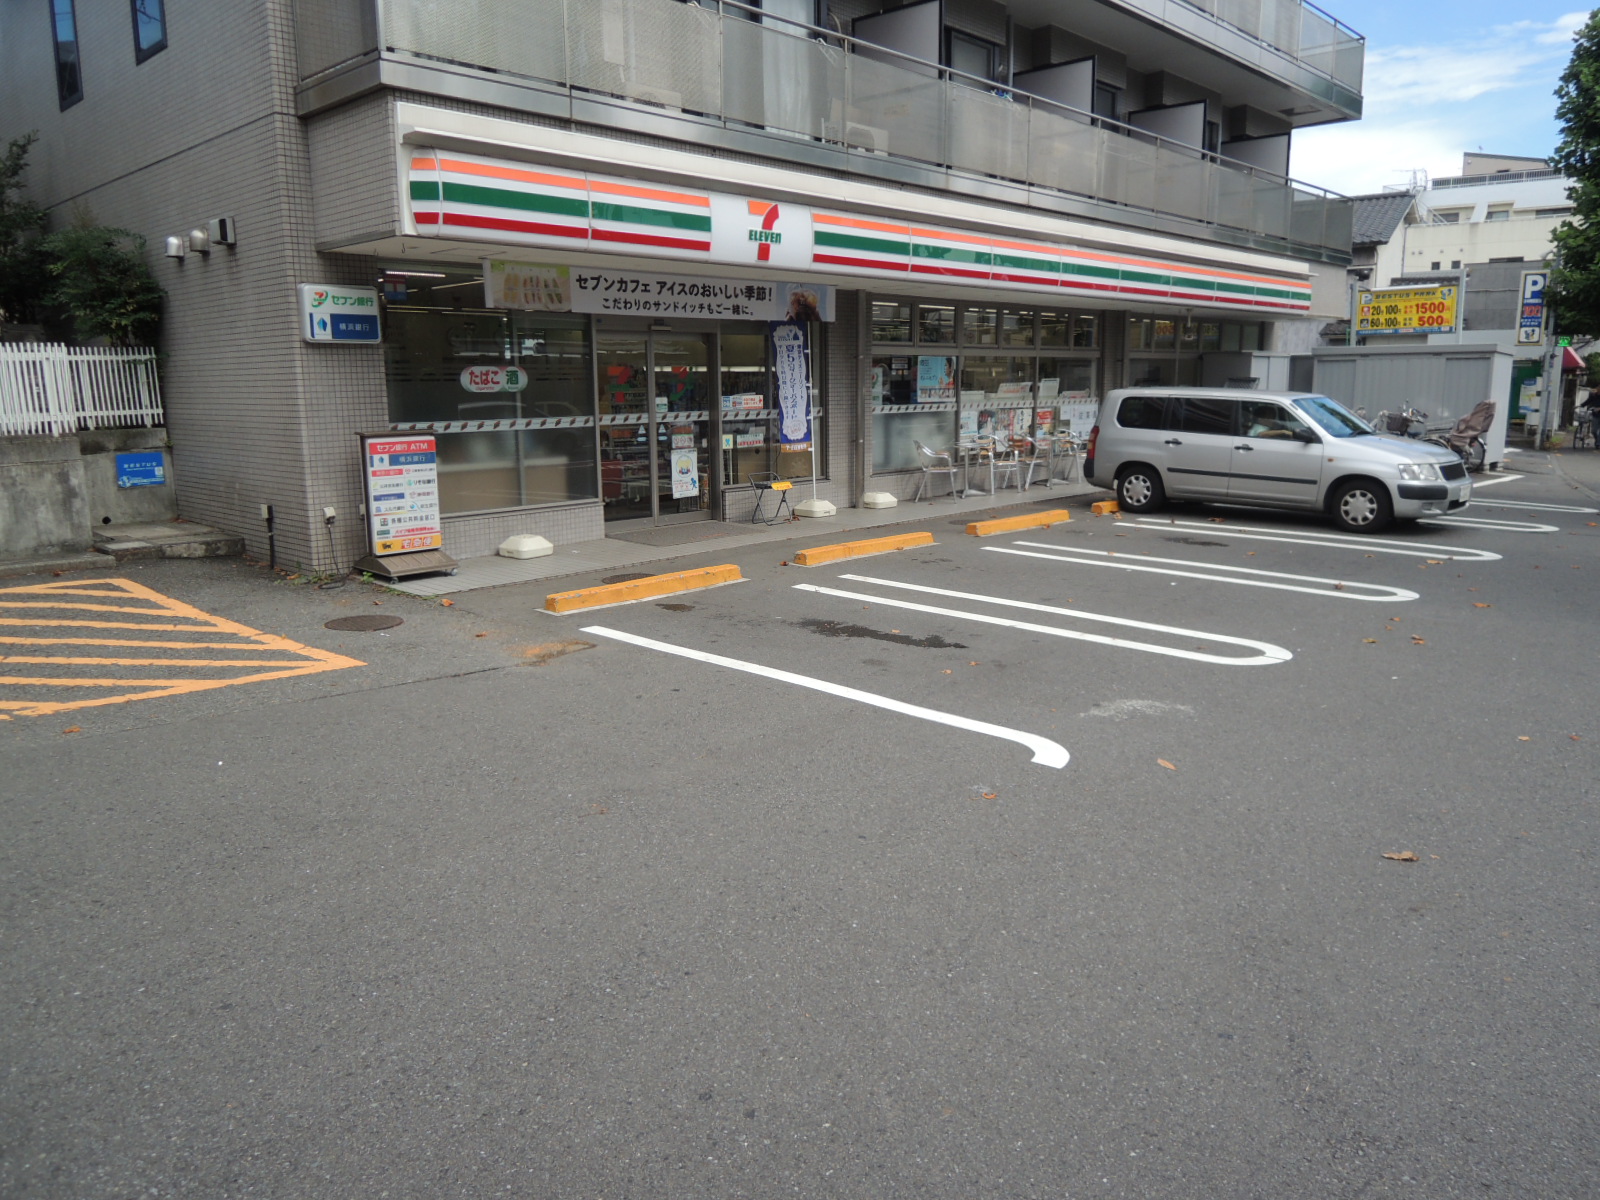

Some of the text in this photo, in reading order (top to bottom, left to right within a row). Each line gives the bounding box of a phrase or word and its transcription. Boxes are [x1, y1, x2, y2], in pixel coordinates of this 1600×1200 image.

[575, 274, 651, 294] セブンカフェ
[1524, 275, 1544, 298] P
[331, 294, 374, 307] セブン銀行
[602, 297, 754, 316] こだわりのサンドイッチもご一緒に。
[339, 322, 370, 332] 横浜銀行
[469, 369, 519, 386] たばこ 酒
[377, 442, 428, 452] セブン銀行 ATM
